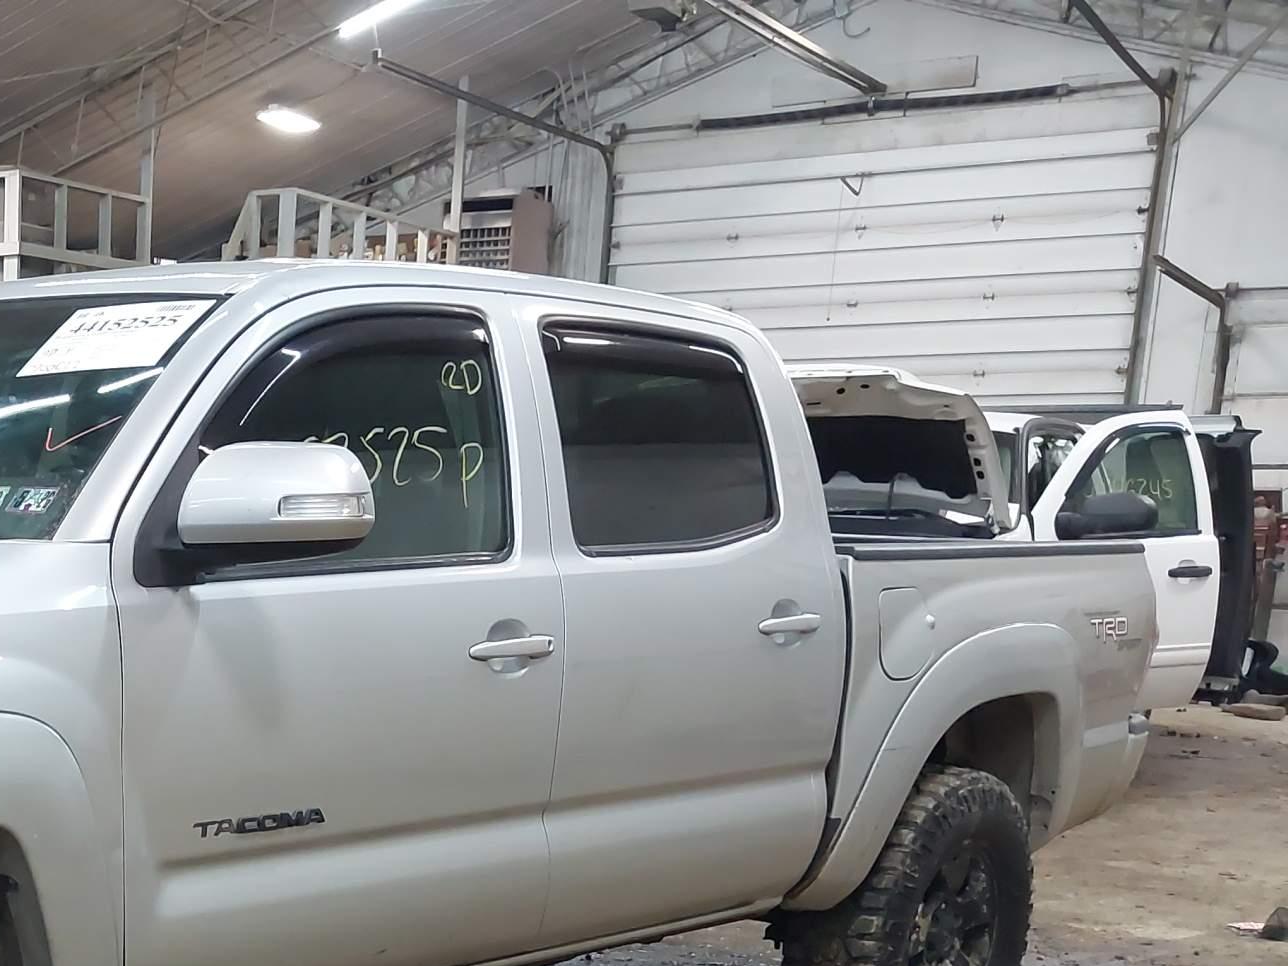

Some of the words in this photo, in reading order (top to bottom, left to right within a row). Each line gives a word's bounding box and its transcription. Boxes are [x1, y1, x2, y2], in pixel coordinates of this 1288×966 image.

[70, 304, 184, 334] 44152525
[1090, 616, 1128, 643] TRD
[193, 807, 326, 838] TACOMA
